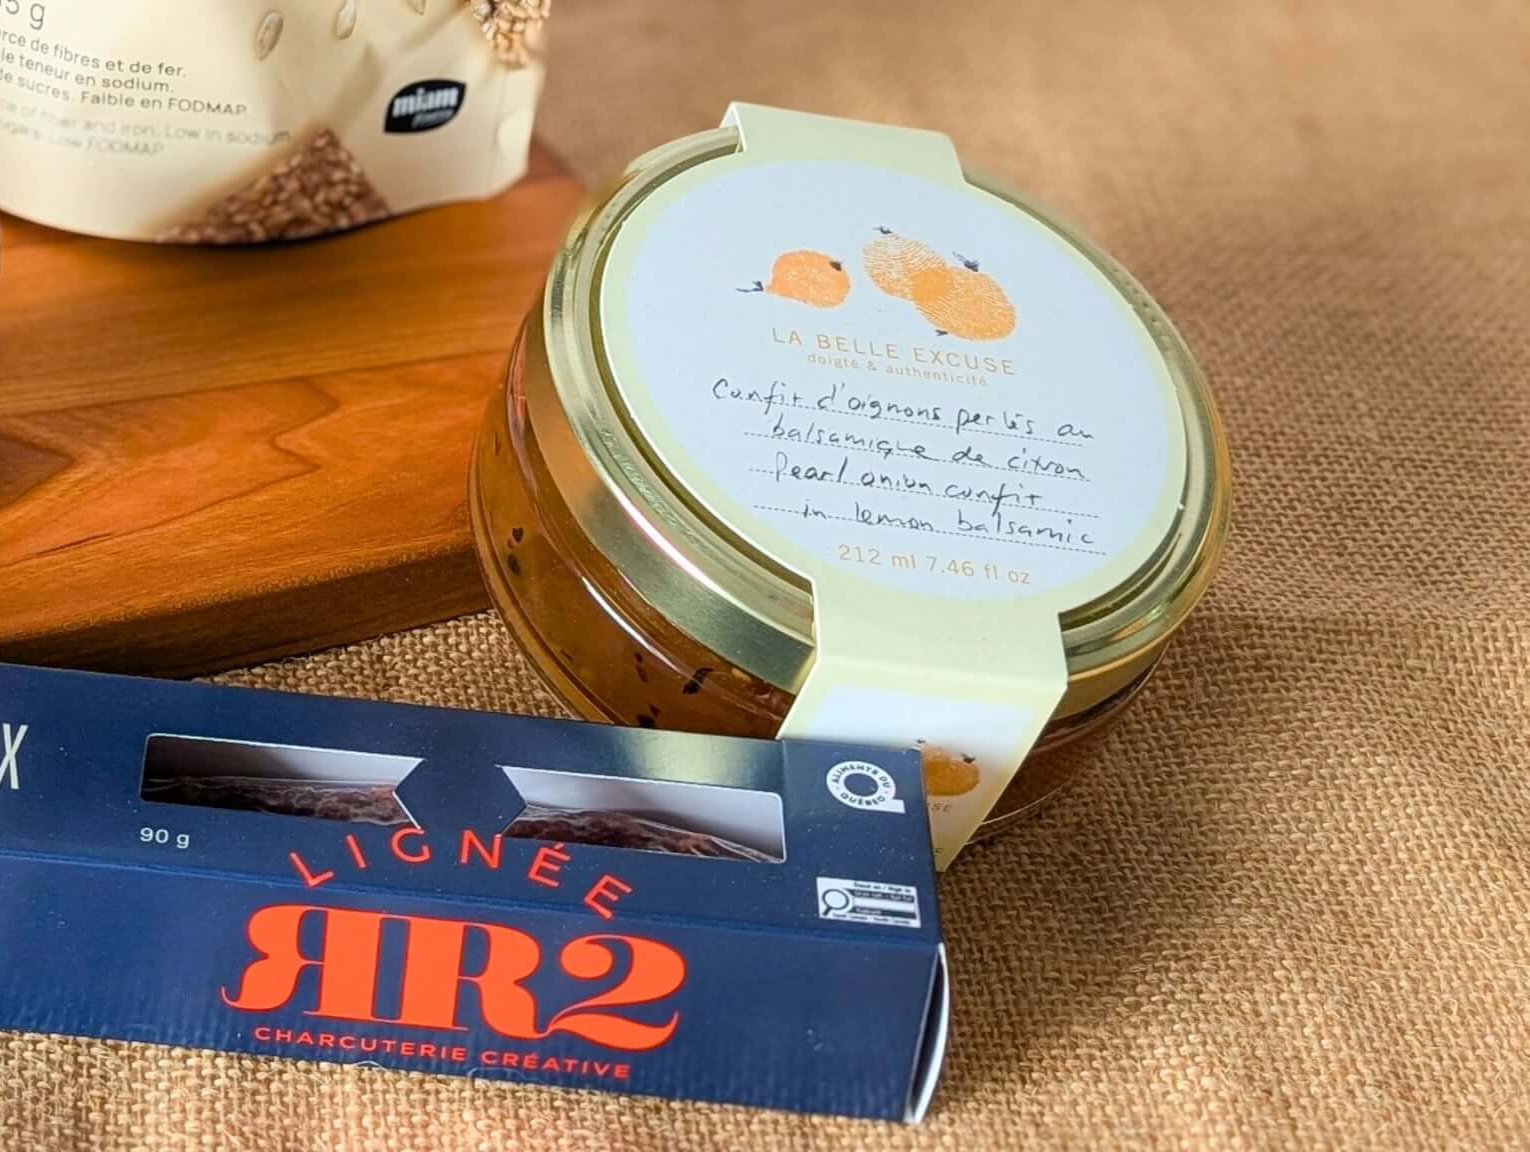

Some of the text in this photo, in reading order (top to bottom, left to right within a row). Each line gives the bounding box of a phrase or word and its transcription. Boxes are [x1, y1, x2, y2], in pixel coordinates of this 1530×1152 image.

[29, 3, 46, 31] g
[19, 54, 70, 81] teneur
[75, 74, 96, 88] en
[102, 76, 174, 93] sodium.
[30, 38, 50, 55] de
[53, 44, 100, 69] fibres
[105, 59, 124, 73] et
[129, 61, 152, 74] de
[158, 62, 187, 78] fer.
[80, 90, 135, 108] Faible
[140, 97, 162, 110] en
[772, 327, 1015, 376] LA BELLE EXCUSE
[886, 364, 988, 387] authenticité
[773, 412, 1086, 478] balsamique de citron
[860, 471, 933, 496] onion
[803, 499, 1094, 544] in lemon balsamic
[838, 544, 1031, 585] 212 ml 7.46 fl oz
[140, 826, 191, 849] 90 g
[289, 824, 633, 920] LIGNÉE
[254, 1026, 631, 1079] CHARCUTERIE CRÉATIVE
